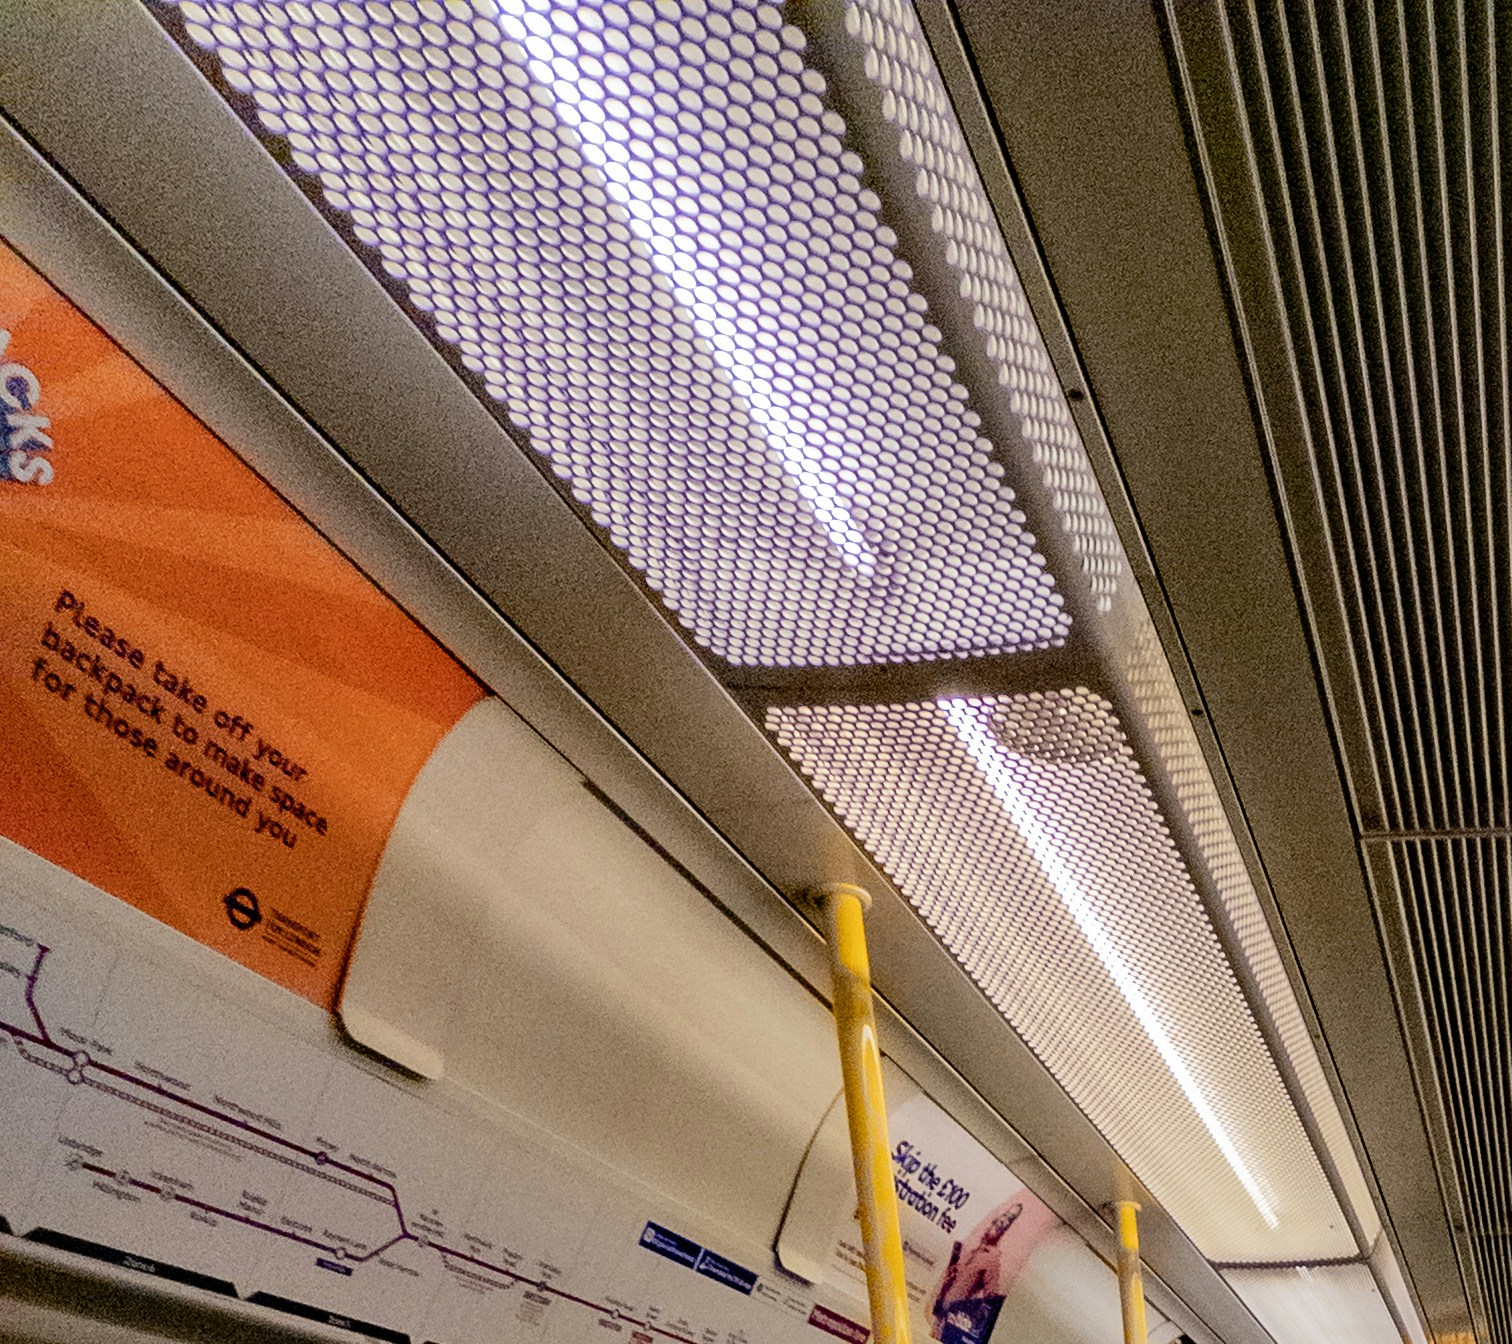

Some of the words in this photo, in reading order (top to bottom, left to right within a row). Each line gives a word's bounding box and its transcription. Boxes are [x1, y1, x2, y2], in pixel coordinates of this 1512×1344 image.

[0, 329, 55, 485] CKS
[31, 657, 77, 701] for
[84, 695, 158, 758] those
[165, 752, 251, 818] around
[255, 812, 297, 849] you
[41, 621, 166, 724] backpack
[173, 713, 198, 745] to
[203, 740, 265, 793] make
[270, 785, 328, 836] space
[54, 589, 144, 668] Please
[153, 660, 207, 713] take
[214, 709, 253, 741] off
[252, 737, 309, 782] your
[892, 1140, 921, 1177] Skip
[918, 1163, 940, 1190] the
[938, 1178, 971, 1209] £100
[936, 1208, 957, 1234] fee
